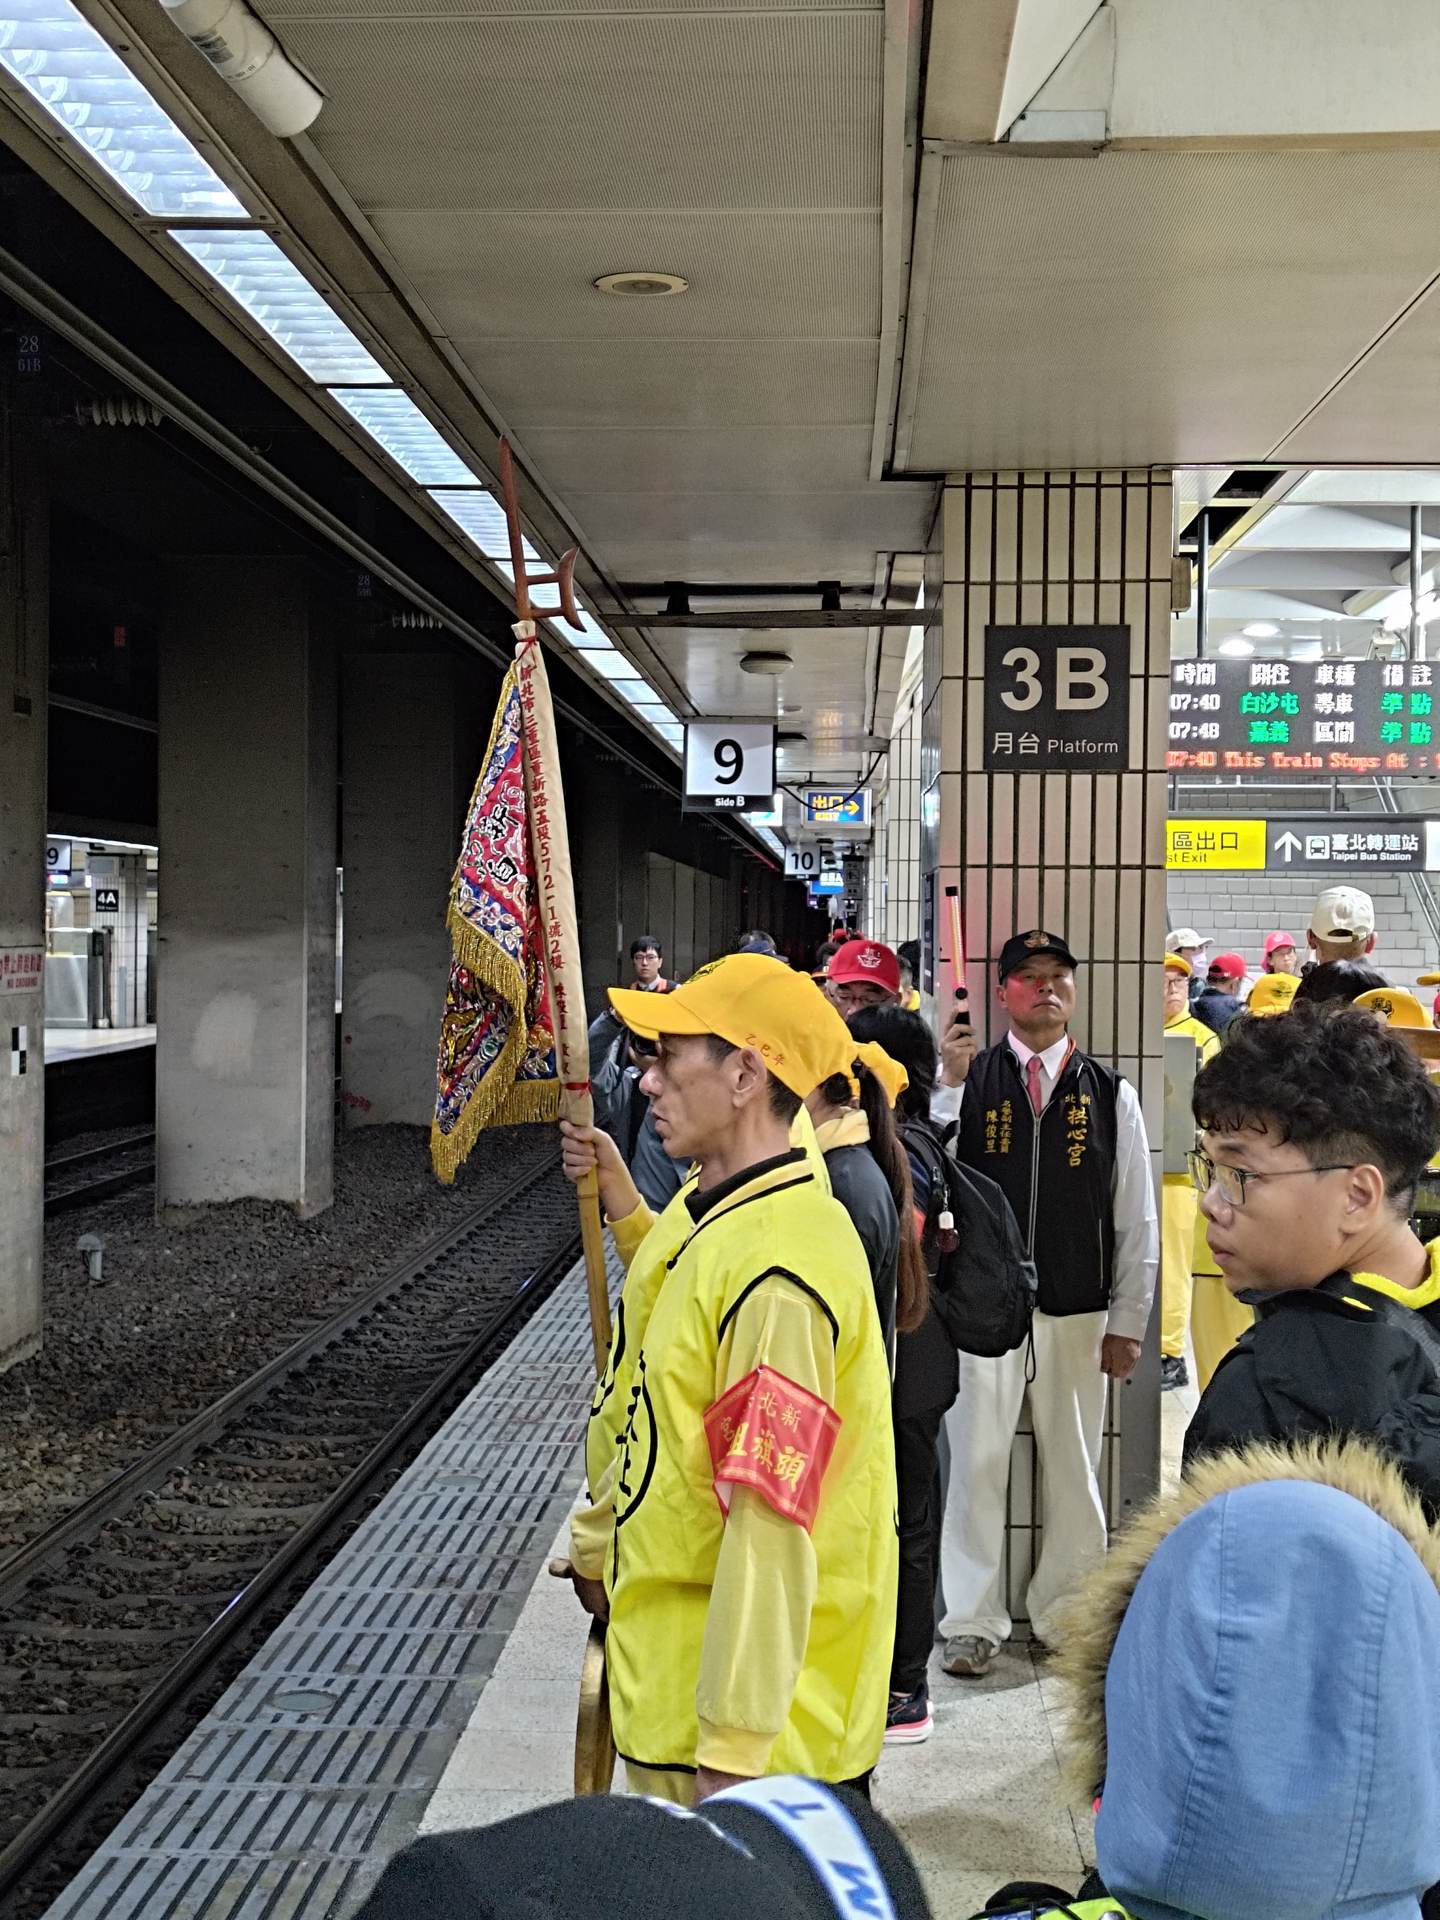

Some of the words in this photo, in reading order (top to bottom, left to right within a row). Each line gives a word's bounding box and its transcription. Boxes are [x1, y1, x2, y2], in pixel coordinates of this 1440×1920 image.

[19, 335, 39, 353] 28
[1000, 646, 1110, 712] 3B
[1174, 663, 1216, 685] 時間
[1250, 663, 1290, 685] 開往
[1315, 664, 1356, 686] 車種
[1169, 693, 1221, 711] 07:40
[1240, 692, 1300, 715] 白沙屯
[1314, 693, 1354, 715] 專車
[1168, 722, 1220, 740] 07:48
[1248, 721, 1290, 744] 嘉義
[1312, 721, 1355, 744] 區間
[992, 731, 1040, 754] 月台
[1048, 739, 1119, 753] Platform
[713, 738, 744, 785] 9
[1223, 751, 1265, 768] This
[1269, 751, 1323, 768] Train
[1329, 752, 1381, 771] Stops
[714, 797, 735, 807] Side
[736, 796, 746, 807] B
[812, 795, 844, 811] 出口
[1172, 831, 1238, 850] 區出口
[1331, 833, 1419, 851] 臺北轉運站
[47, 847, 59, 866] 9
[791, 851, 814, 870] 10
[1181, 852, 1207, 863] Exit
[1331, 852, 1358, 862] Taipei
[1359, 852, 1378, 861] Bus
[1380, 852, 1412, 861] Station
[97, 891, 116, 905] 4A
[1067, 1105, 1089, 1168] 拱心宮
